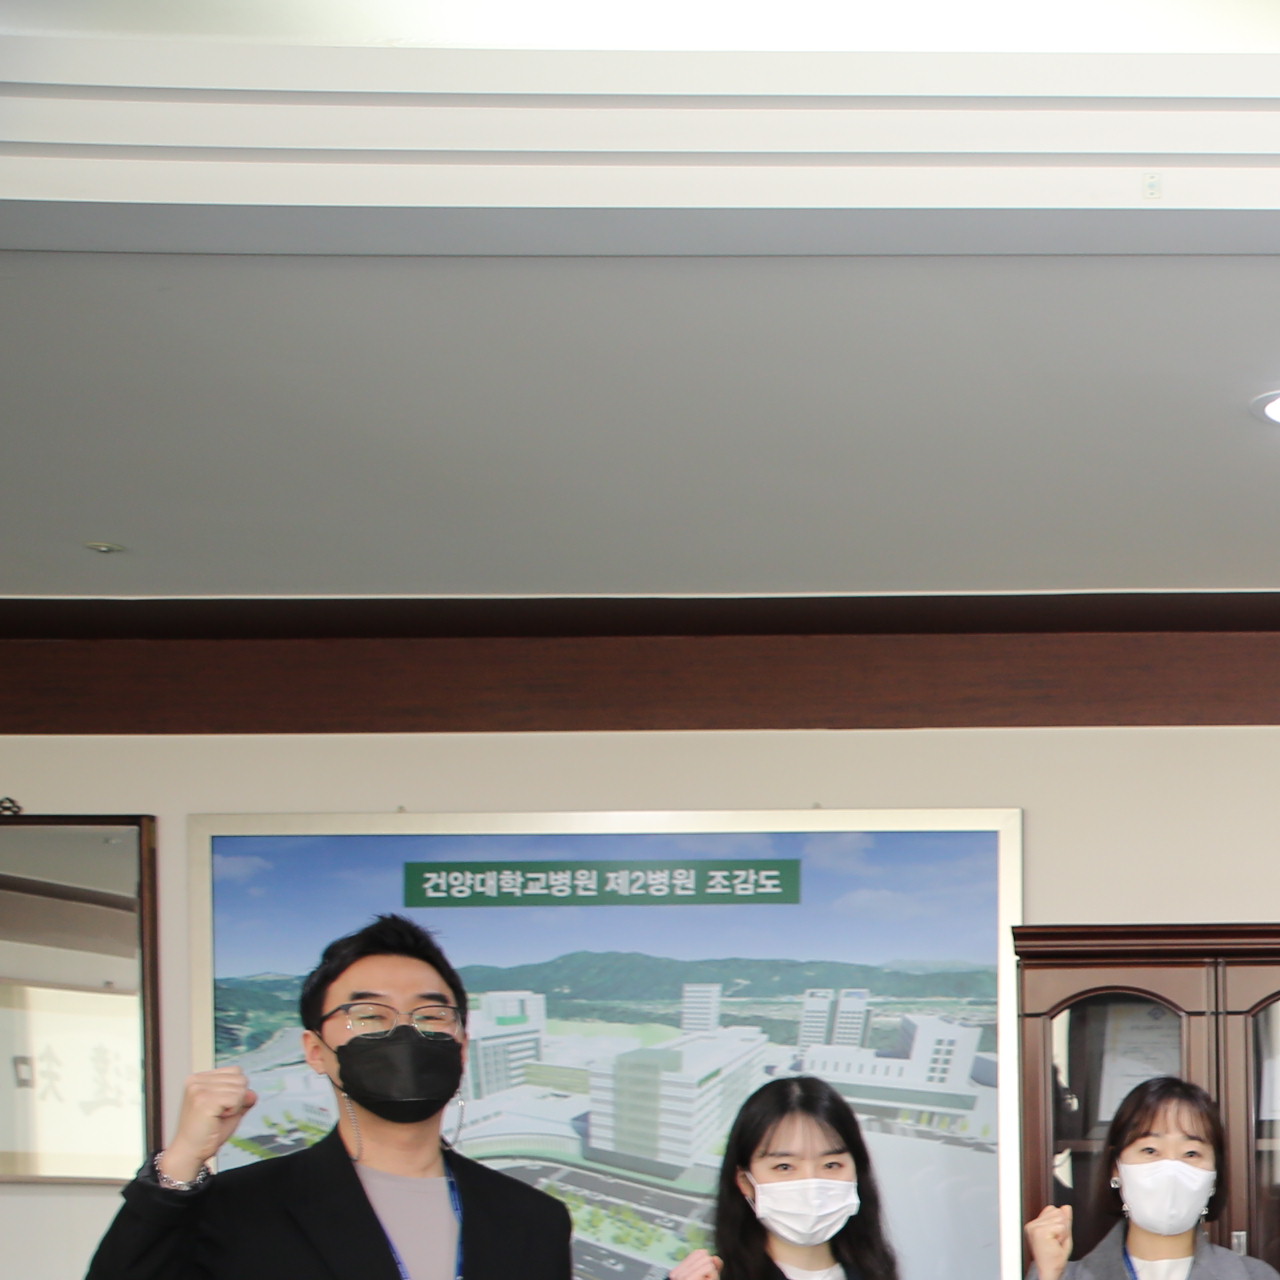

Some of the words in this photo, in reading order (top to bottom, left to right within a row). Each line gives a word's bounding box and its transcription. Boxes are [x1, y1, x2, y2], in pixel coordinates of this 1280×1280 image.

[422, 869, 599, 898] 건양대학교병원
[604, 868, 697, 896] 제2병원
[705, 868, 784, 895] 조감도
